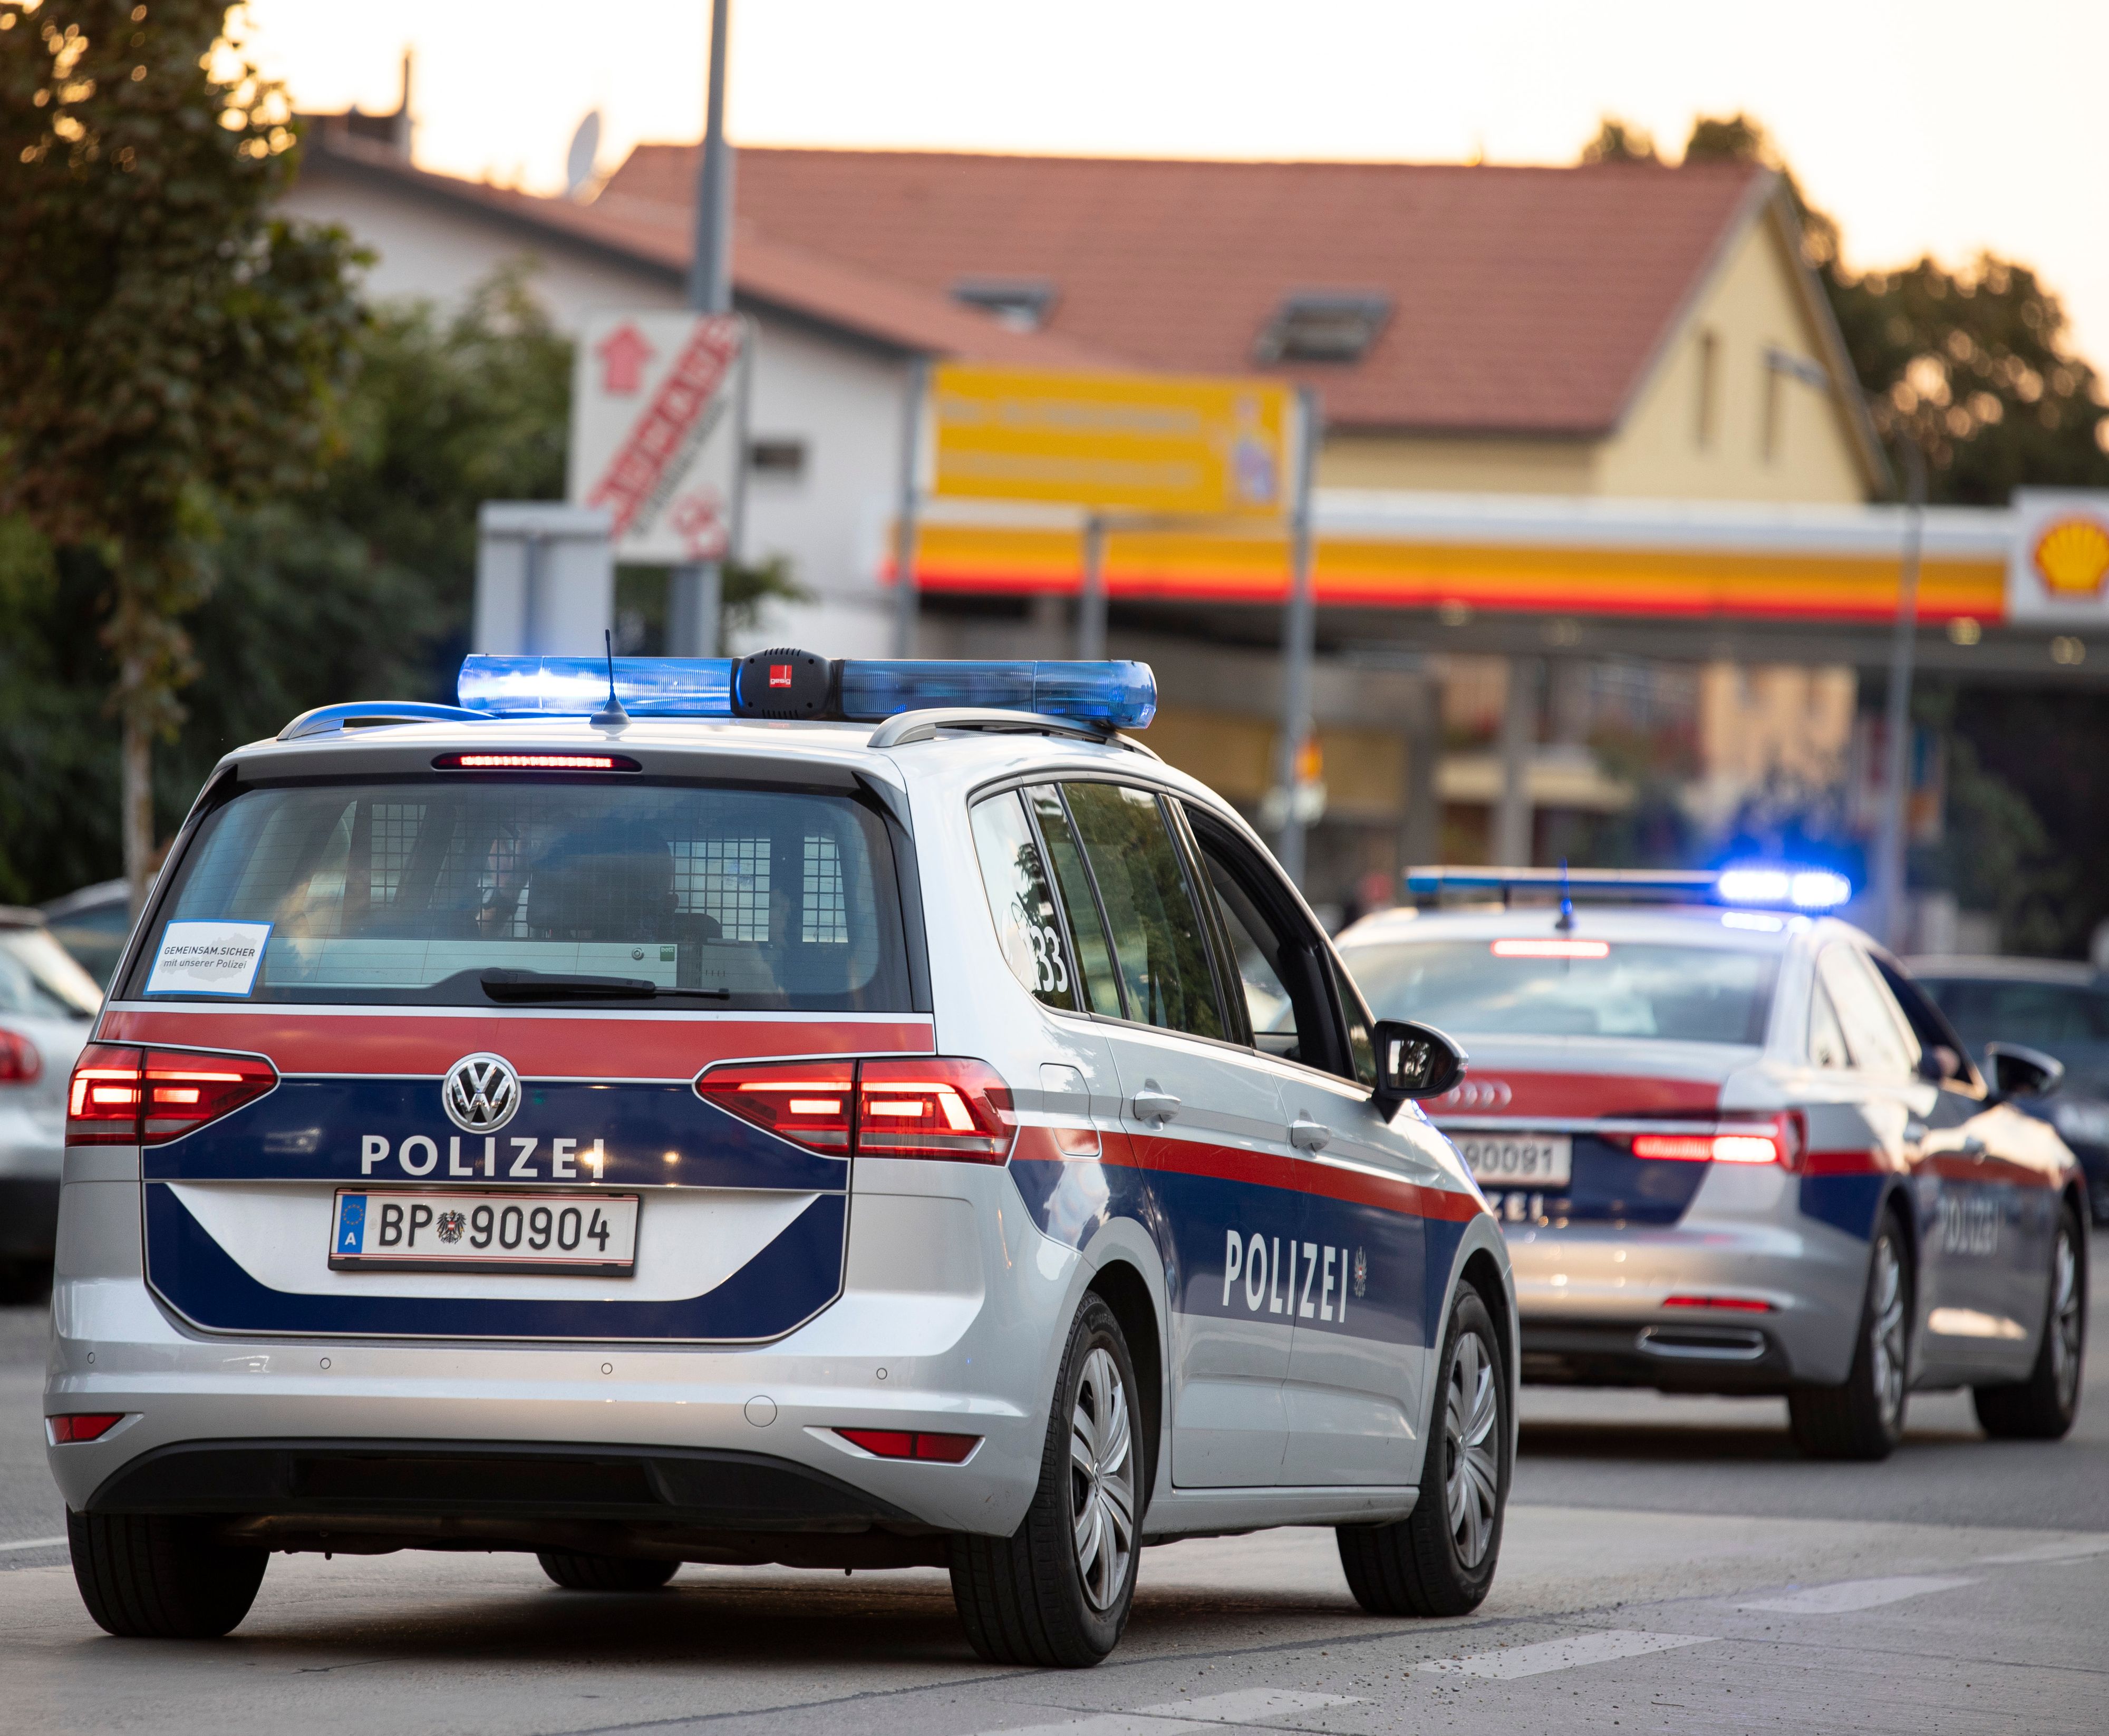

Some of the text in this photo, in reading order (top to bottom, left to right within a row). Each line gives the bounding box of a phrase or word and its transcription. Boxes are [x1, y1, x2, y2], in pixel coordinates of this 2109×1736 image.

[165, 946, 255, 957] GEMEINSAM.SICHER
[217, 959, 247, 969] Polizei
[362, 1134, 604, 1179] POLIZEI
[344, 1232, 356, 1245] A
[379, 1204, 610, 1252] BP 90904
[1222, 1229, 1348, 1323] POLIZEI
